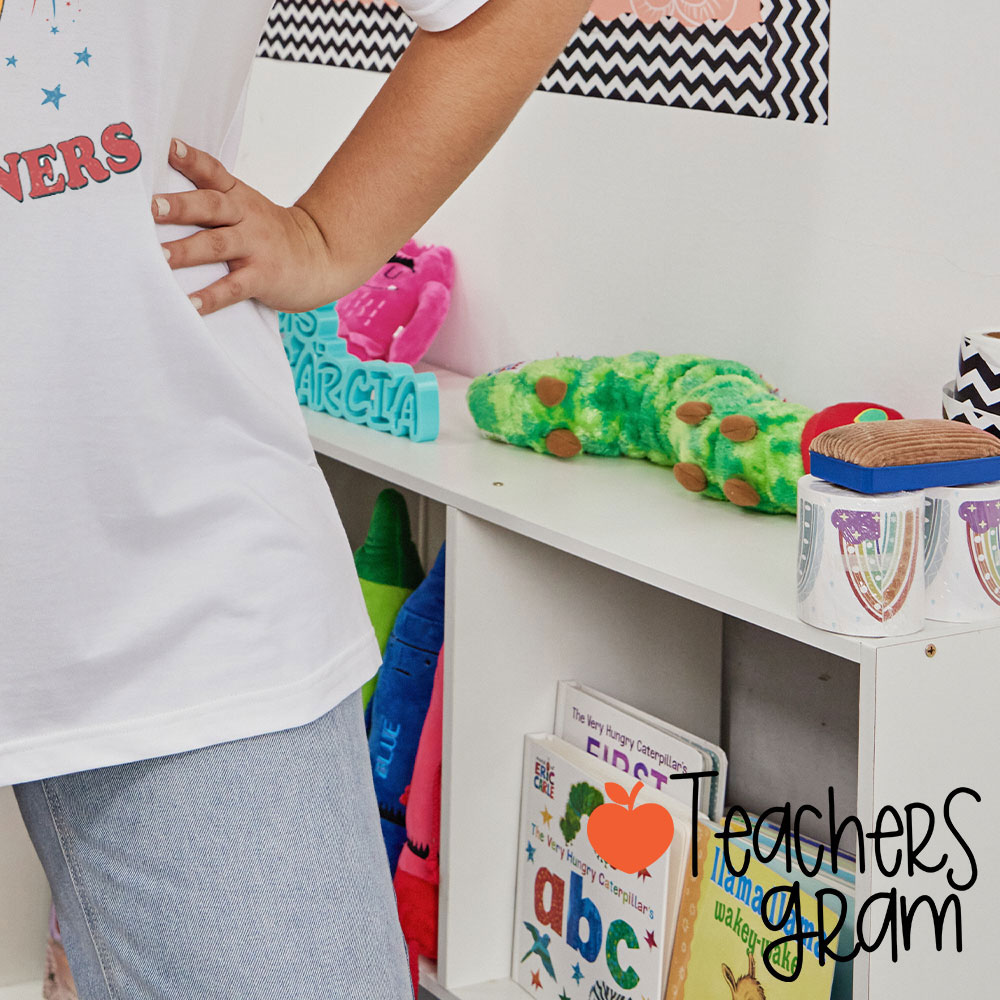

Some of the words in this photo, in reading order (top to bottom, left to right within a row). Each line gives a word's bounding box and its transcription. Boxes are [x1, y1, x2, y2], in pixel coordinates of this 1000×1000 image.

[375, 719, 401, 779] BLUE
[571, 706, 586, 724] The
[587, 713, 605, 735] Very
[606, 723, 635, 751] Hungry
[636, 739, 689, 775] Caterpillar's
[534, 775, 555, 800] CARLE
[535, 761, 556, 786] ERIC
[531, 822, 545, 843] The
[546, 834, 566, 861] Very
[566, 848, 597, 884] Hungry
[598, 870, 655, 920] Caterpillar's
[533, 866, 640, 990] abc
